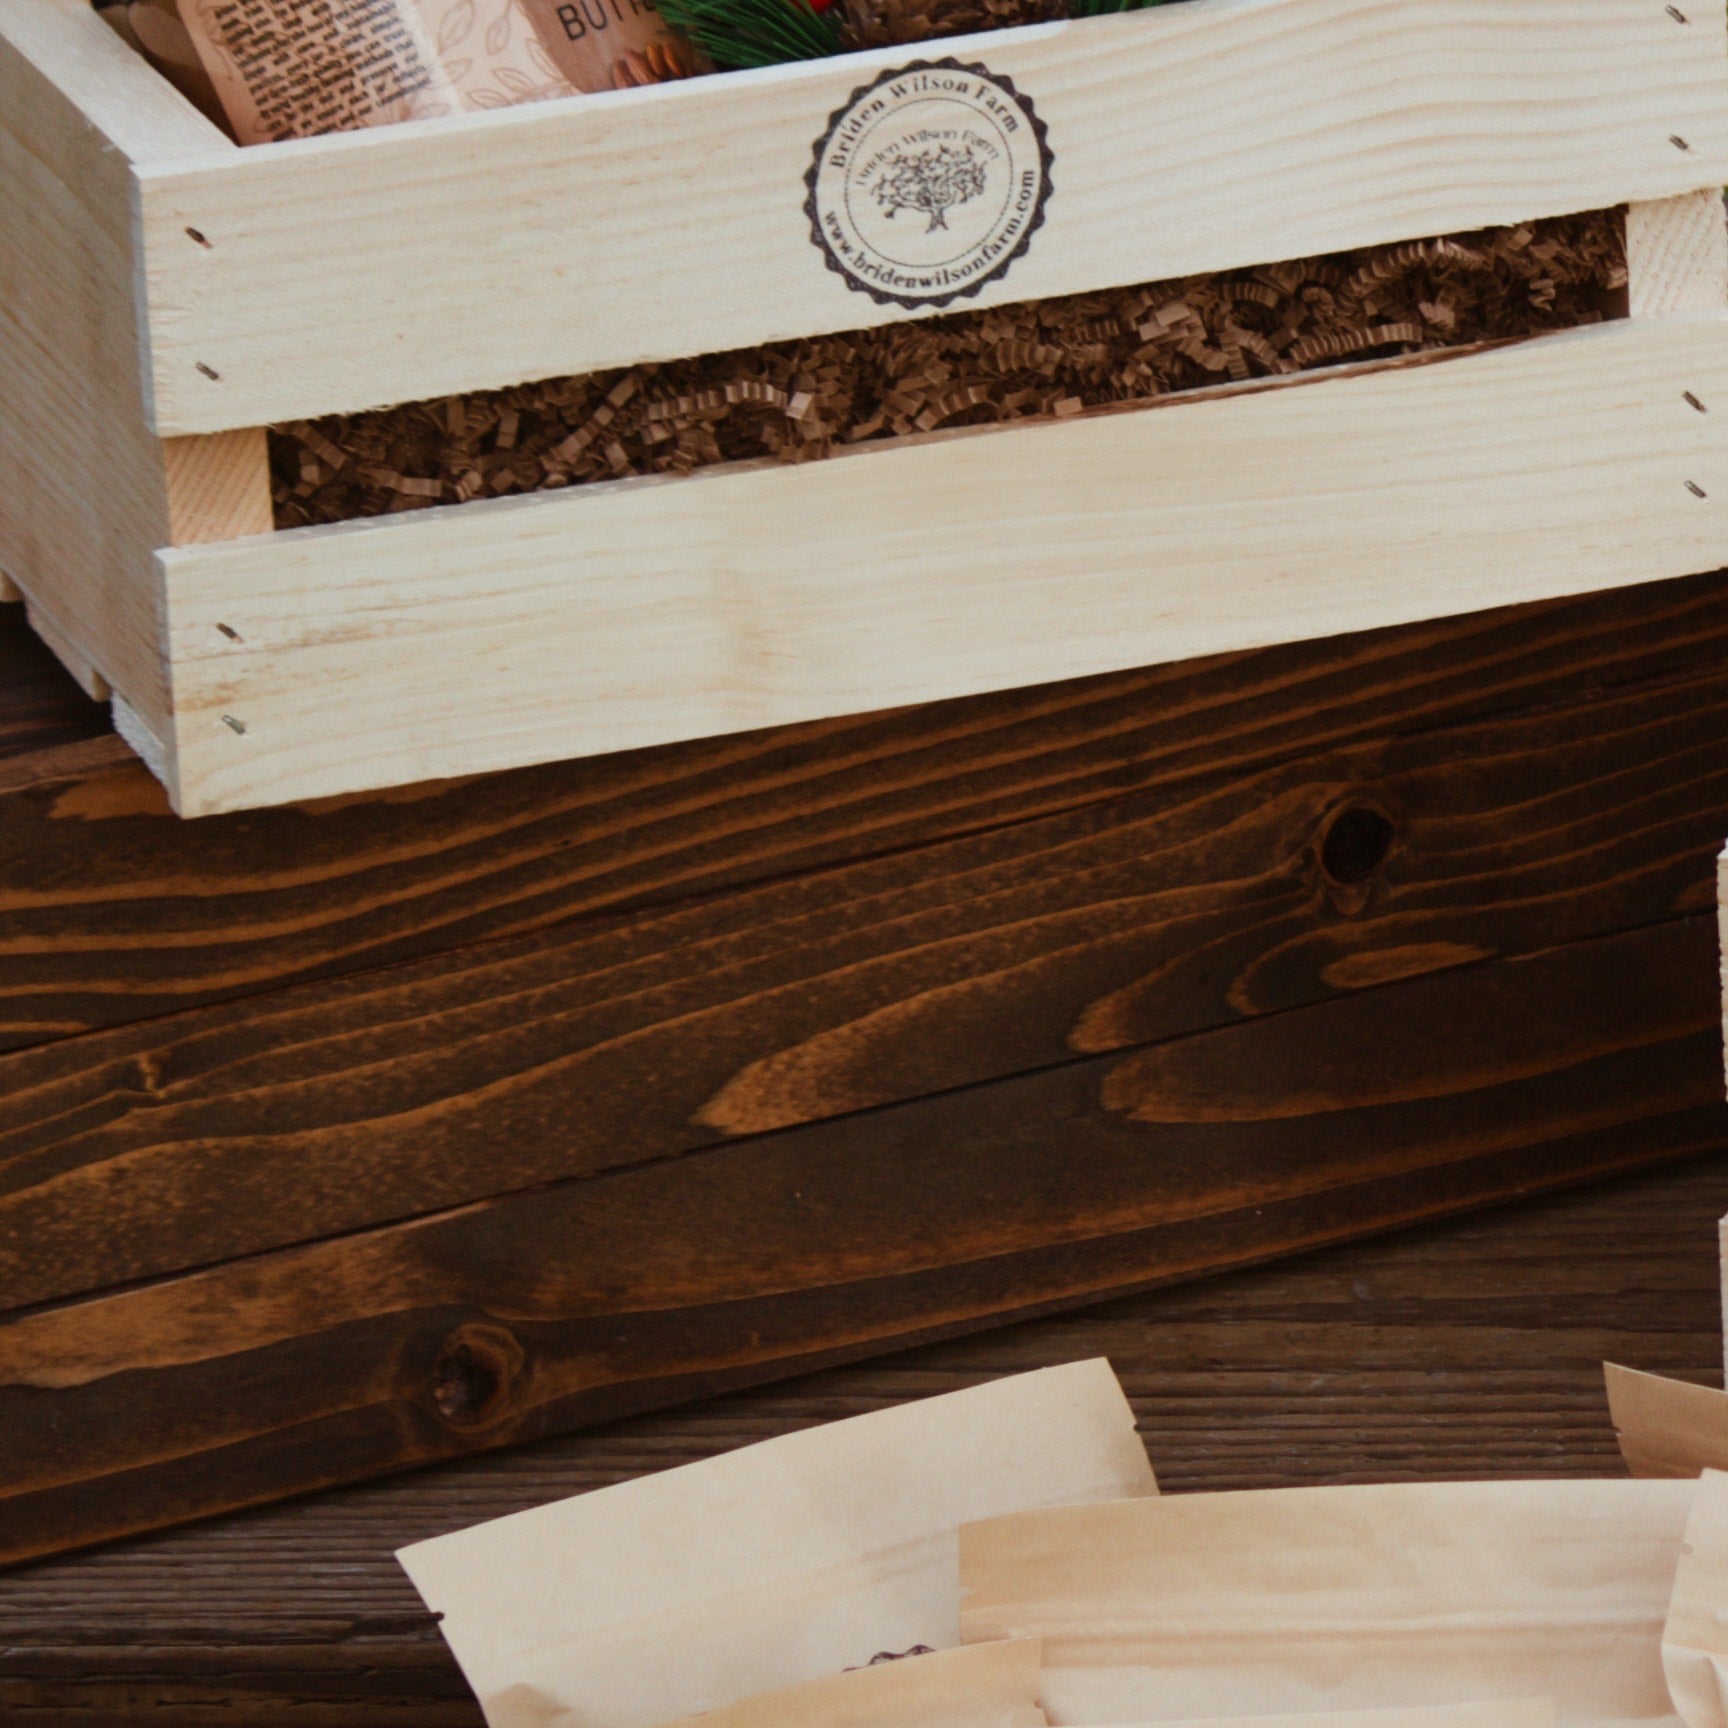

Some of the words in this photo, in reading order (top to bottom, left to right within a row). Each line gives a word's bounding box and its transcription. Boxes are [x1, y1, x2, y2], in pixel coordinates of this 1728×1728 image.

[830, 99, 885, 168] Briden
[889, 75, 969, 97] Wilson
[974, 83, 1019, 134] Farm
[855, 142, 900, 186] Briden
[902, 129, 958, 145] Wilson
[961, 129, 999, 161] Farm
[825, 169, 1034, 289] www.bridenwilsonfarm.com
